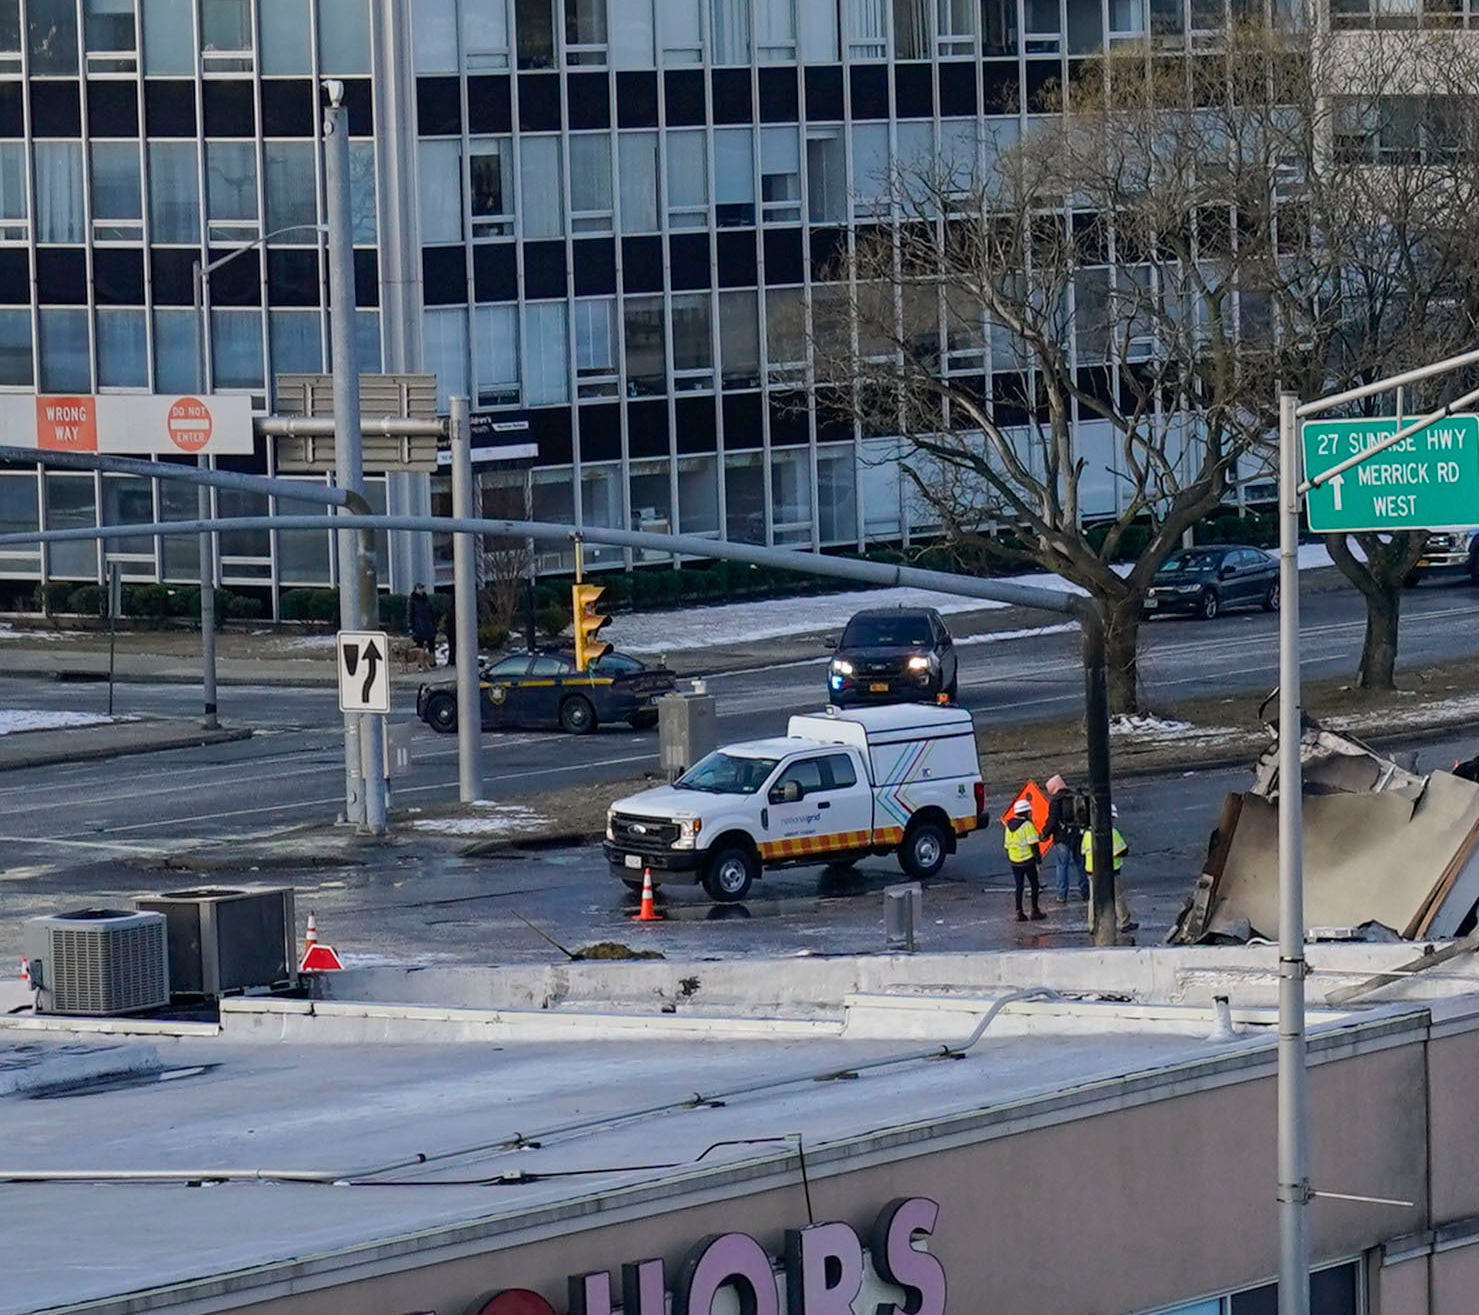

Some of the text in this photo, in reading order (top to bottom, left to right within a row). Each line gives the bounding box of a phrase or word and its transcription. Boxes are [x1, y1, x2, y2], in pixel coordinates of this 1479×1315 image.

[45, 406, 87, 422] WRONG
[171, 405, 207, 417] DO NOT
[54, 426, 80, 441] WAY
[176, 432, 206, 443] ENTER
[1317, 434, 1339, 455] 27
[1426, 429, 1467, 451] HWY
[1357, 462, 1460, 486] MERRICK RD
[1373, 495, 1417, 517] WEST
